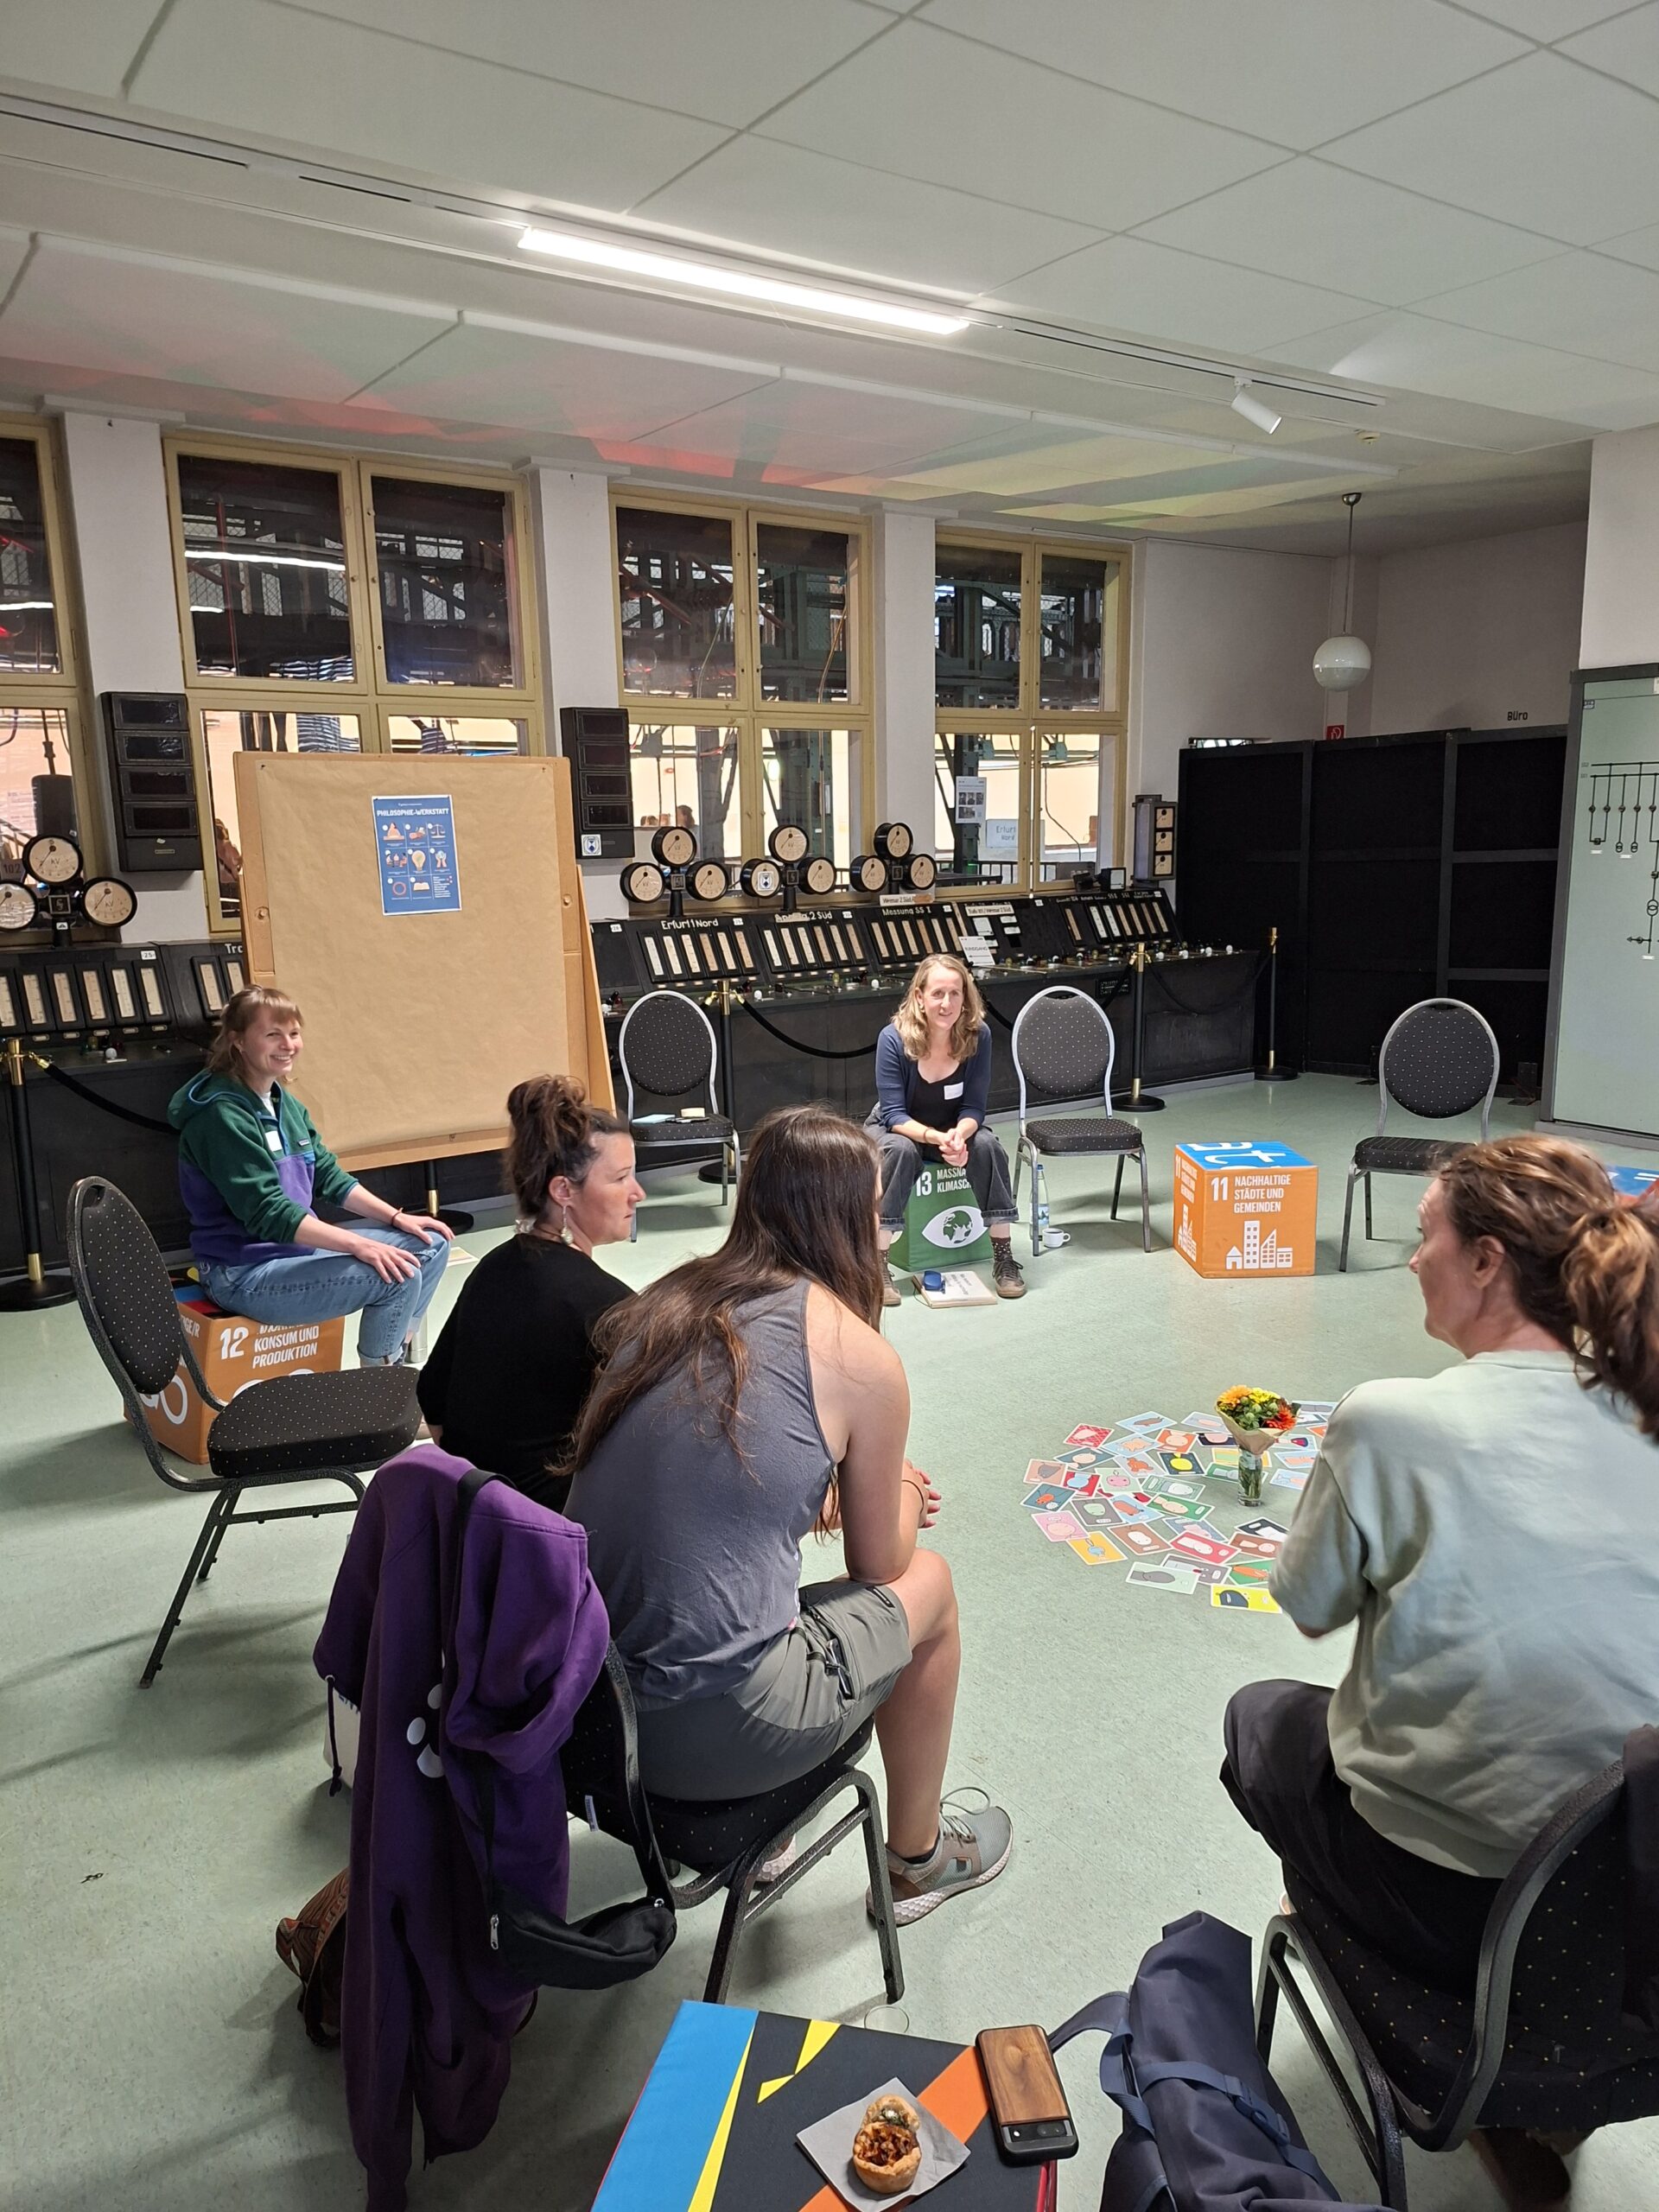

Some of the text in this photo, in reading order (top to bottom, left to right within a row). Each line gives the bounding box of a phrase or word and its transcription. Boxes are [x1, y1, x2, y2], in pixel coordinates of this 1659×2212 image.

[1507, 711, 1529, 721] Büro
[377, 808, 449, 817] PHILOSOPHIE-WERKSTATT
[809, 912, 817, 920] 2
[661, 919, 690, 930] Erfurt
[695, 918, 719, 928] Nord
[916, 1171, 932, 1197] 13
[1234, 1174, 1292, 1187] NACHHALTIGE
[1211, 1177, 1229, 1202] 11
[1234, 1187, 1284, 1200] STÄDTE UND
[1234, 1201, 1281, 1214] GEMEINDEN
[219, 1326, 250, 1360] 12
[254, 1331, 298, 1353] KONSUM
[299, 1325, 320, 1343] UND
[252, 1342, 318, 1370] PRODUKTION
